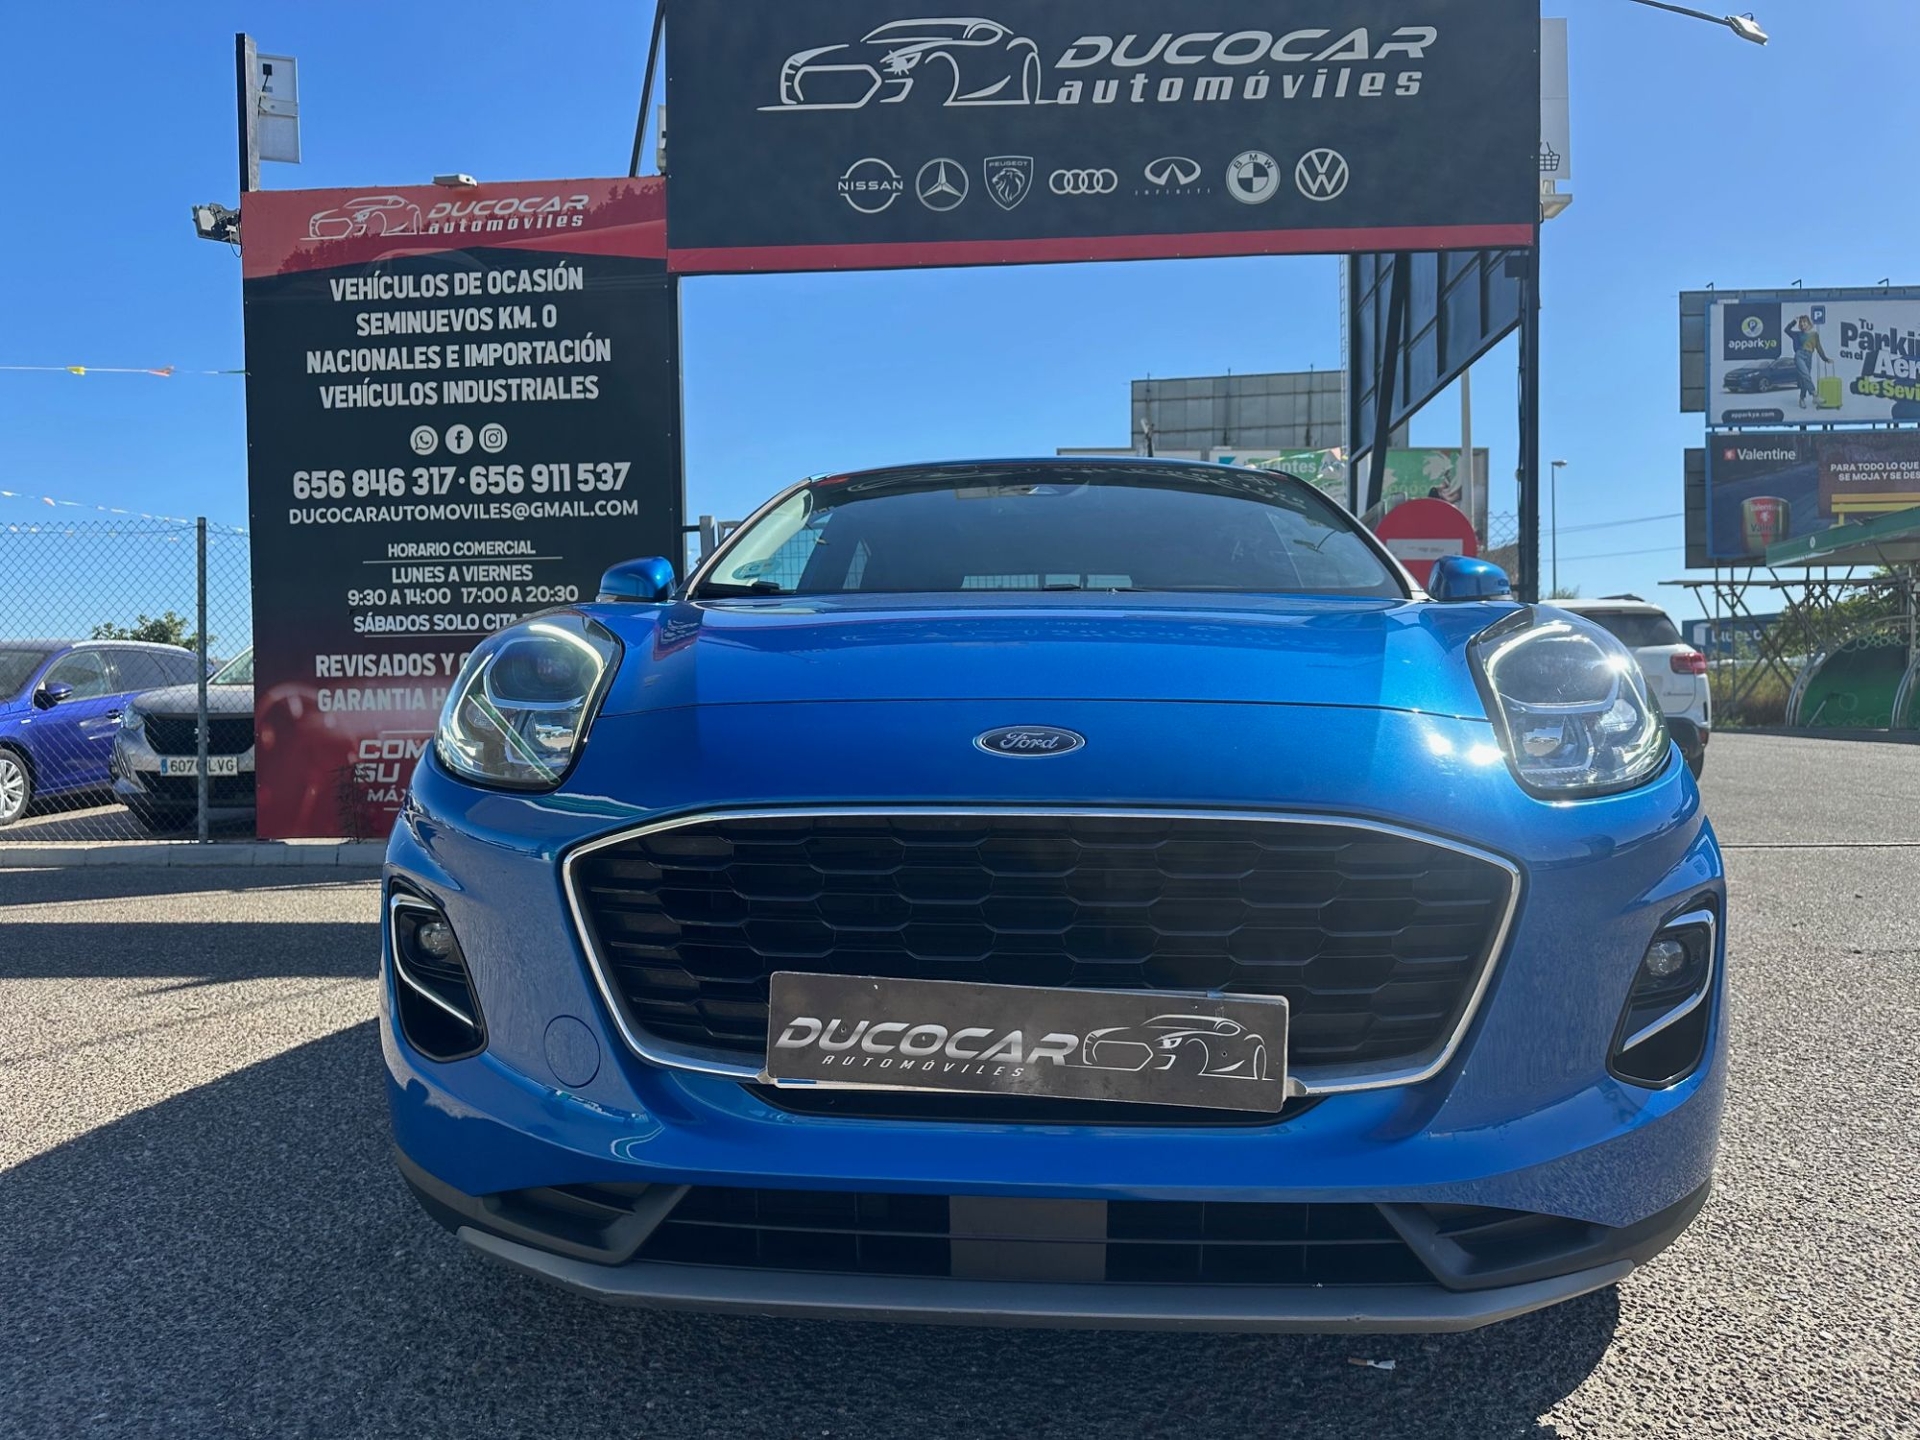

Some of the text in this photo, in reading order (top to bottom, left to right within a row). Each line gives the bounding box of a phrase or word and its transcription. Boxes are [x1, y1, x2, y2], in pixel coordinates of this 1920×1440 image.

[1053, 26, 1438, 68] DUCOCAR
[1056, 68, 1423, 105] automóviles
[988, 160, 1029, 168] PEUGEOT
[837, 180, 904, 191] NISSAN
[427, 195, 590, 219] DUCOCAR
[428, 212, 583, 235] automóviles
[329, 260, 583, 302] VEHÍCULOS DE OCASIÓN
[355, 307, 494, 337] SEMINUEVOS
[498, 305, 538, 330] KM.
[1858, 317, 1874, 331] Tu
[306, 332, 612, 374] NACIONALES E IMPORTACIÓN
[1728, 338, 1777, 350] apparkya
[1840, 350, 1863, 360] en el
[319, 375, 600, 409] VEHÍCULOS INDUSTRIALES
[1858, 376, 1880, 395] de
[1737, 448, 1796, 461] Valentine
[1830, 461, 1919, 472] PARA TODO LO QUE
[1838, 473, 1851, 481] SE
[1852, 472, 1881, 481] MOJA
[1881, 472, 1888, 480] Y
[1889, 472, 1902, 480] SE
[292, 470, 346, 499] 656
[351, 467, 406, 498] 846
[531, 463, 571, 493] 911
[577, 461, 632, 492] 537
[288, 499, 639, 525] DUCOCARAUTOMOVILES@GMAIL.COM
[388, 540, 536, 558] HORARIO COMERCIAL
[391, 564, 534, 584] LUNES A VIERNES
[347, 584, 579, 606] 9:30 A 14:00 17:00 A 20:30
[353, 612, 430, 633] SÁBADOS
[433, 613, 480, 631] SOLO
[315, 653, 437, 678] REVISADOS
[440, 652, 456, 676] Y
[317, 687, 427, 712] GARANTIA
[1000, 732, 1060, 749] Ford
[208, 759, 234, 773] LVG
[774, 1016, 1080, 1067] DUCOCAR
[821, 1054, 1026, 1078] AUTOMÓVILES
